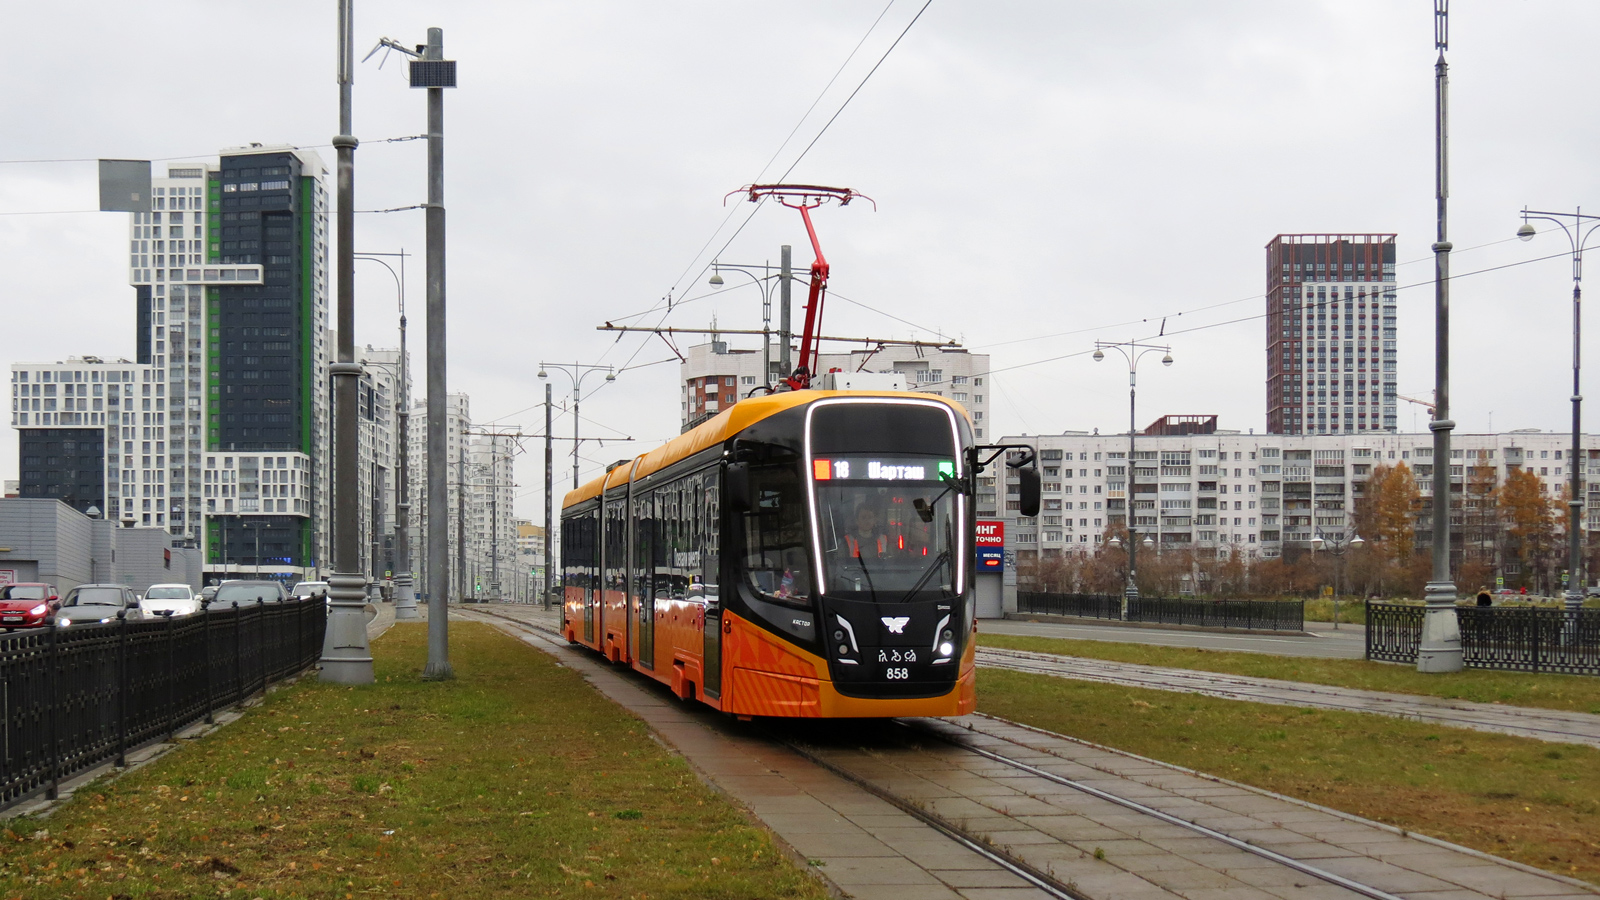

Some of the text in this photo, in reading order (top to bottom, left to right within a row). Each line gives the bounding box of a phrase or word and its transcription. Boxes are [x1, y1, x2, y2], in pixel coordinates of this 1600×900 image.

[834, 461, 925, 481] 18 Шарташ
[886, 667, 909, 680] 858
